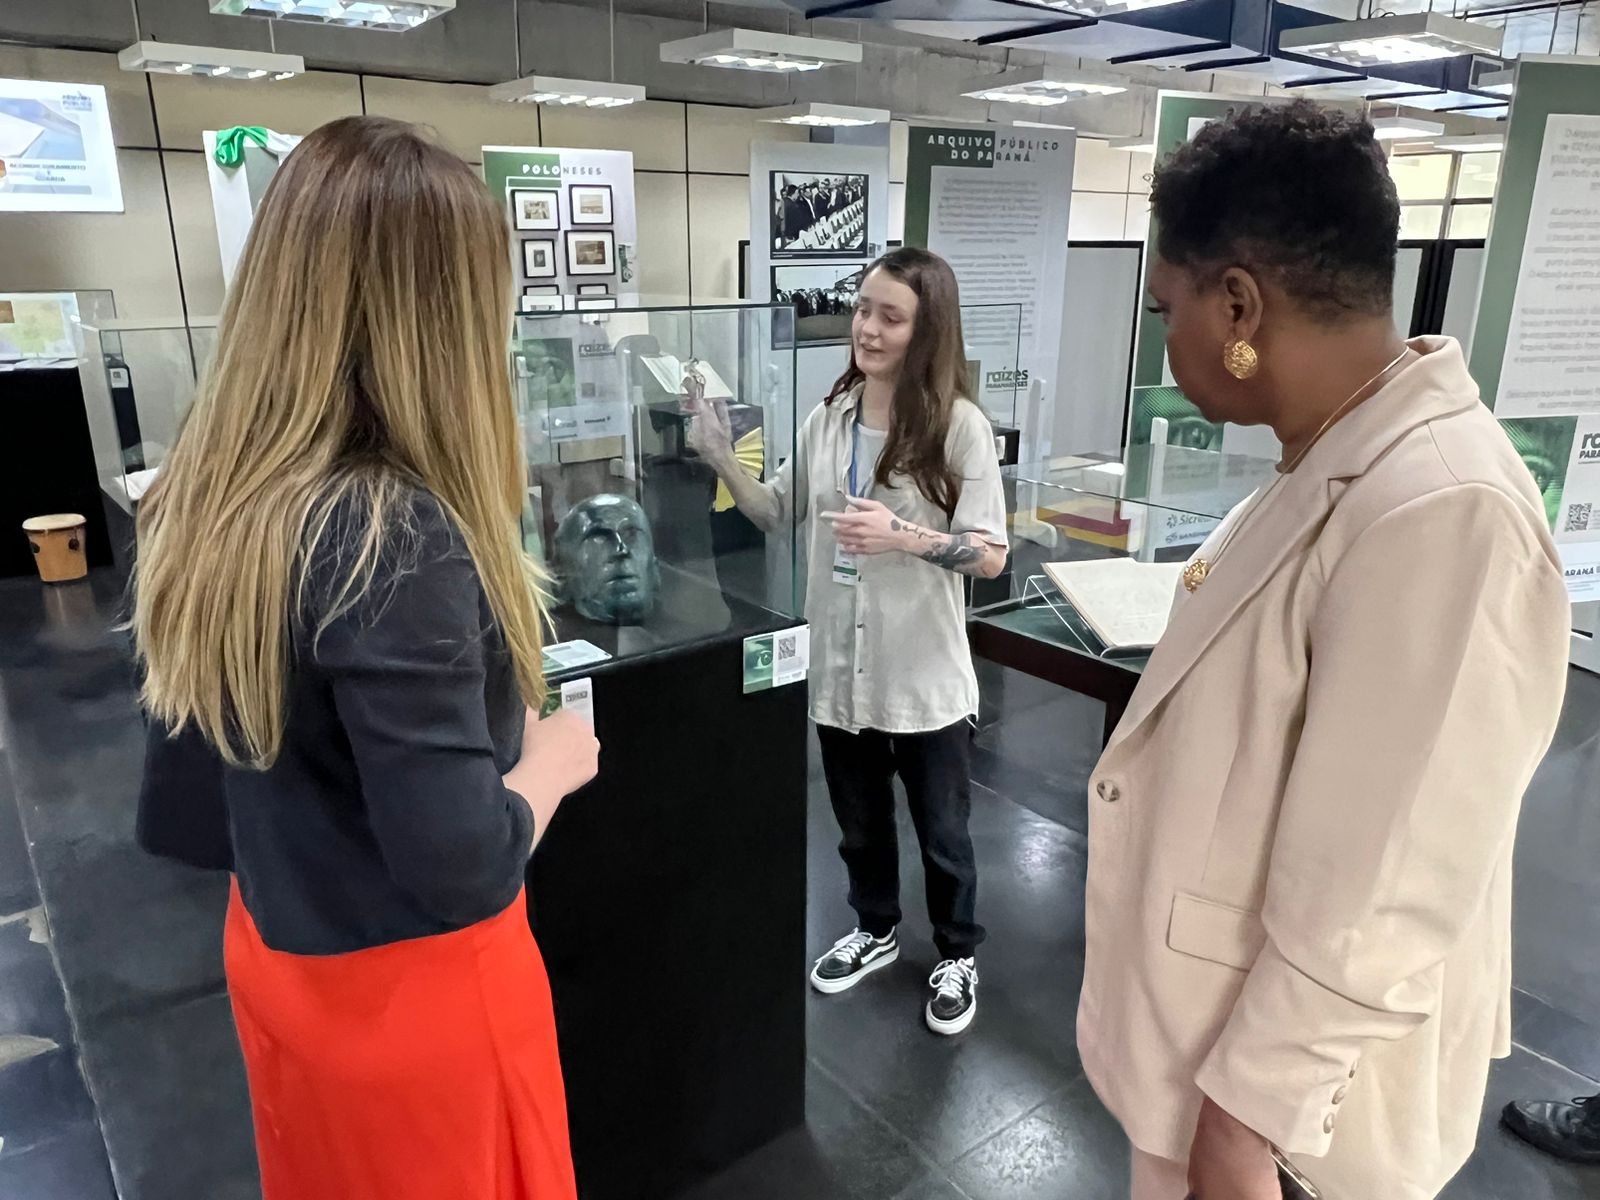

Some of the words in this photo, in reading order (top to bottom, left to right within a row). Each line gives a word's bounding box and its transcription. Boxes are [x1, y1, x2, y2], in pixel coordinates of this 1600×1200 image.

[928, 134, 993, 148] ARQUIVO
[1000, 137, 1060, 151] PÚBLICO
[950, 149, 970, 160] DO
[522, 164, 602, 175] POLONESES
[986, 366, 1028, 383] raízes
